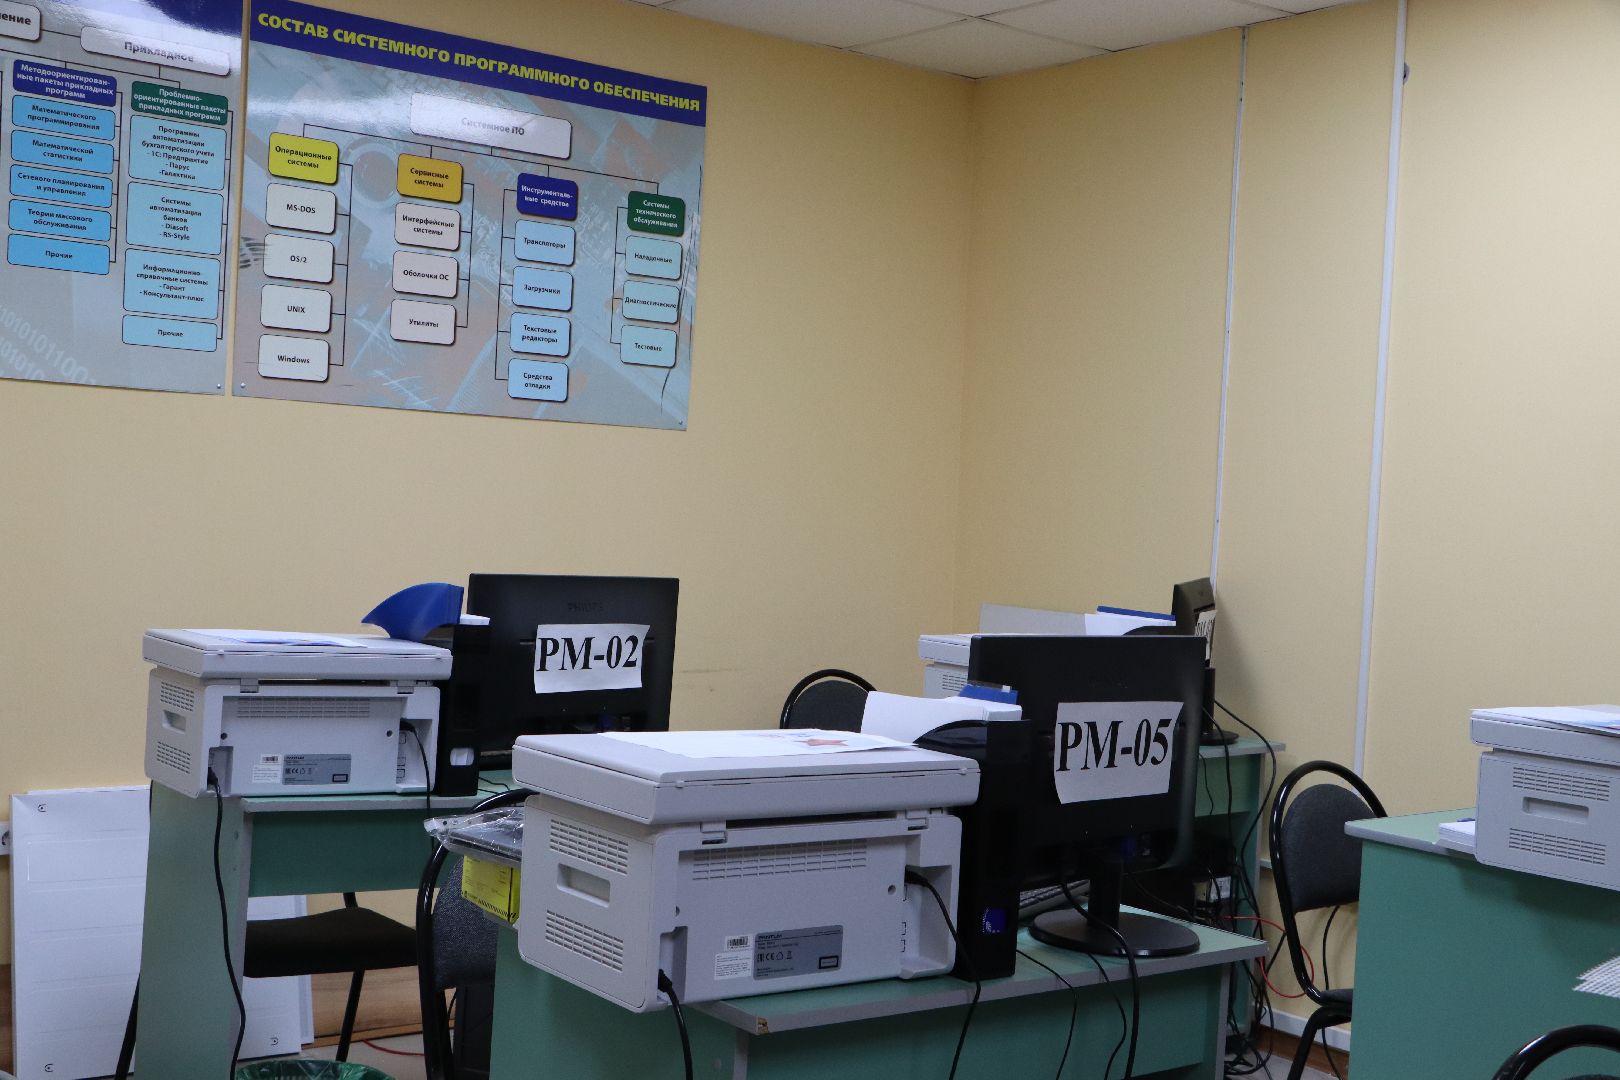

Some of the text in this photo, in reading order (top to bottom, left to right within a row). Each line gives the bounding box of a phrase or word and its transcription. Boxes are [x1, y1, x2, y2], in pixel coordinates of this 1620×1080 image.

[257, 12, 700, 112] СОСТАВ СИСТЕМНОГО ПРОГРАММНОГО ОБЕСПЕЧЕНИЯ
[21, 63, 110, 86] Методоориентирован-
[17, 73, 113, 95] ные пакеты прикладных
[46, 86, 85, 100] программ
[32, 105, 96, 121] Математического
[139, 103, 221, 121] прикладных программ
[27, 115, 100, 131] программирования
[158, 125, 199, 139] Программы
[32, 140, 93, 155] Математической
[43, 152, 82, 162] статистики
[275, 146, 332, 161] Операционные
[287, 159, 319, 169] системы
[410, 167, 449, 180] Сервисные
[17, 173, 105, 191] Сетевого планирования
[414, 179, 444, 188] системы
[43, 186, 87, 197] управления
[521, 185, 573, 199] Инструменталь-
[161, 197, 191, 206] Системы
[540, 197, 570, 208] средства
[643, 200, 670, 209] Системы
[286, 203, 315, 214] MS-DOS
[636, 209, 676, 219] технического
[34, 218, 87, 231] обслуживания
[163, 215, 187, 223] банков
[402, 215, 454, 229] Интерфейсные
[634, 216, 678, 229] обслуживания
[163, 232, 190, 241] RS-Style
[413, 227, 443, 236] системы
[524, 237, 566, 250] Трансляторы
[45, 250, 73, 260] Прочие
[290, 255, 307, 263] OS/2
[634, 252, 672, 263] Наладочные
[403, 269, 438, 280] Оболочки
[163, 283, 185, 292] Гарант
[524, 284, 560, 295] Загрузчики
[287, 305, 305, 313] UNIX
[409, 318, 438, 328] Утилиты
[158, 329, 183, 338] Прочие
[524, 325, 556, 334] Текстовые
[522, 333, 558, 344] редакторы
[635, 342, 662, 351] Тестовые
[278, 355, 310, 364] Windows
[523, 372, 552, 381] Средства
[525, 382, 550, 390] отладки
